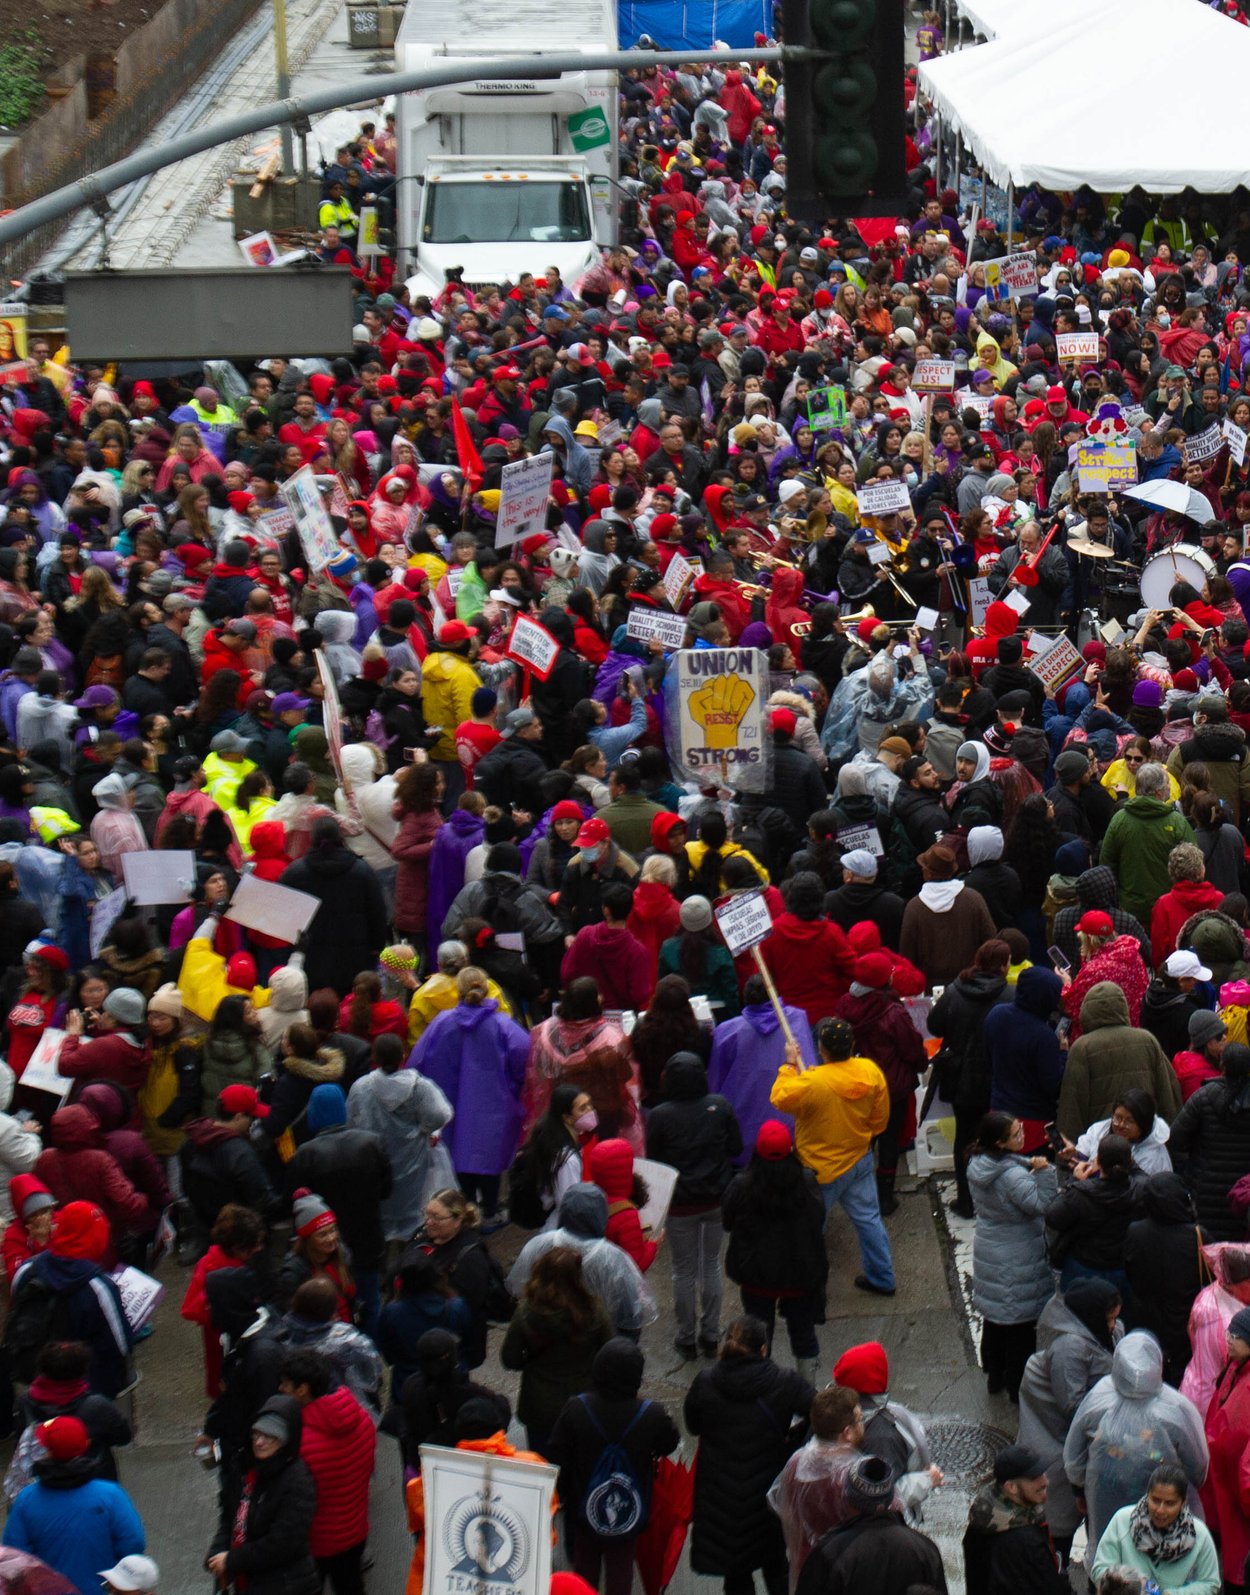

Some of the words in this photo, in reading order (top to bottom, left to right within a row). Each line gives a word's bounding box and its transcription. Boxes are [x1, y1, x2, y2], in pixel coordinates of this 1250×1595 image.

[475, 82, 510, 91] THERMO
[512, 82, 536, 90] KING
[1059, 344, 1096, 355] NOW!
[921, 376, 940, 385] US!
[1186, 437, 1206, 450] QUALITY
[1078, 449, 1125, 467] Strike
[1125, 451, 1134, 465] 4
[1188, 446, 1211, 459] BETTER
[1079, 466, 1136, 485] respect
[874, 487, 901, 496] ESCUELAS
[502, 500, 521, 517] This
[525, 496, 535, 505] is
[502, 517, 518, 529] the
[629, 614, 654, 627] QUALITY
[628, 623, 656, 638] BETTER
[657, 630, 682, 645] LIVES!
[687, 650, 753, 676] UNION
[1035, 663, 1048, 675] WE
[1045, 641, 1071, 665] DEMAND
[1042, 648, 1079, 683] RESPECT!
[704, 711, 740, 726] RESIST
[740, 726, 758, 738] 721
[686, 747, 760, 766] STRONG
[728, 905, 753, 923] ESCUELAS
